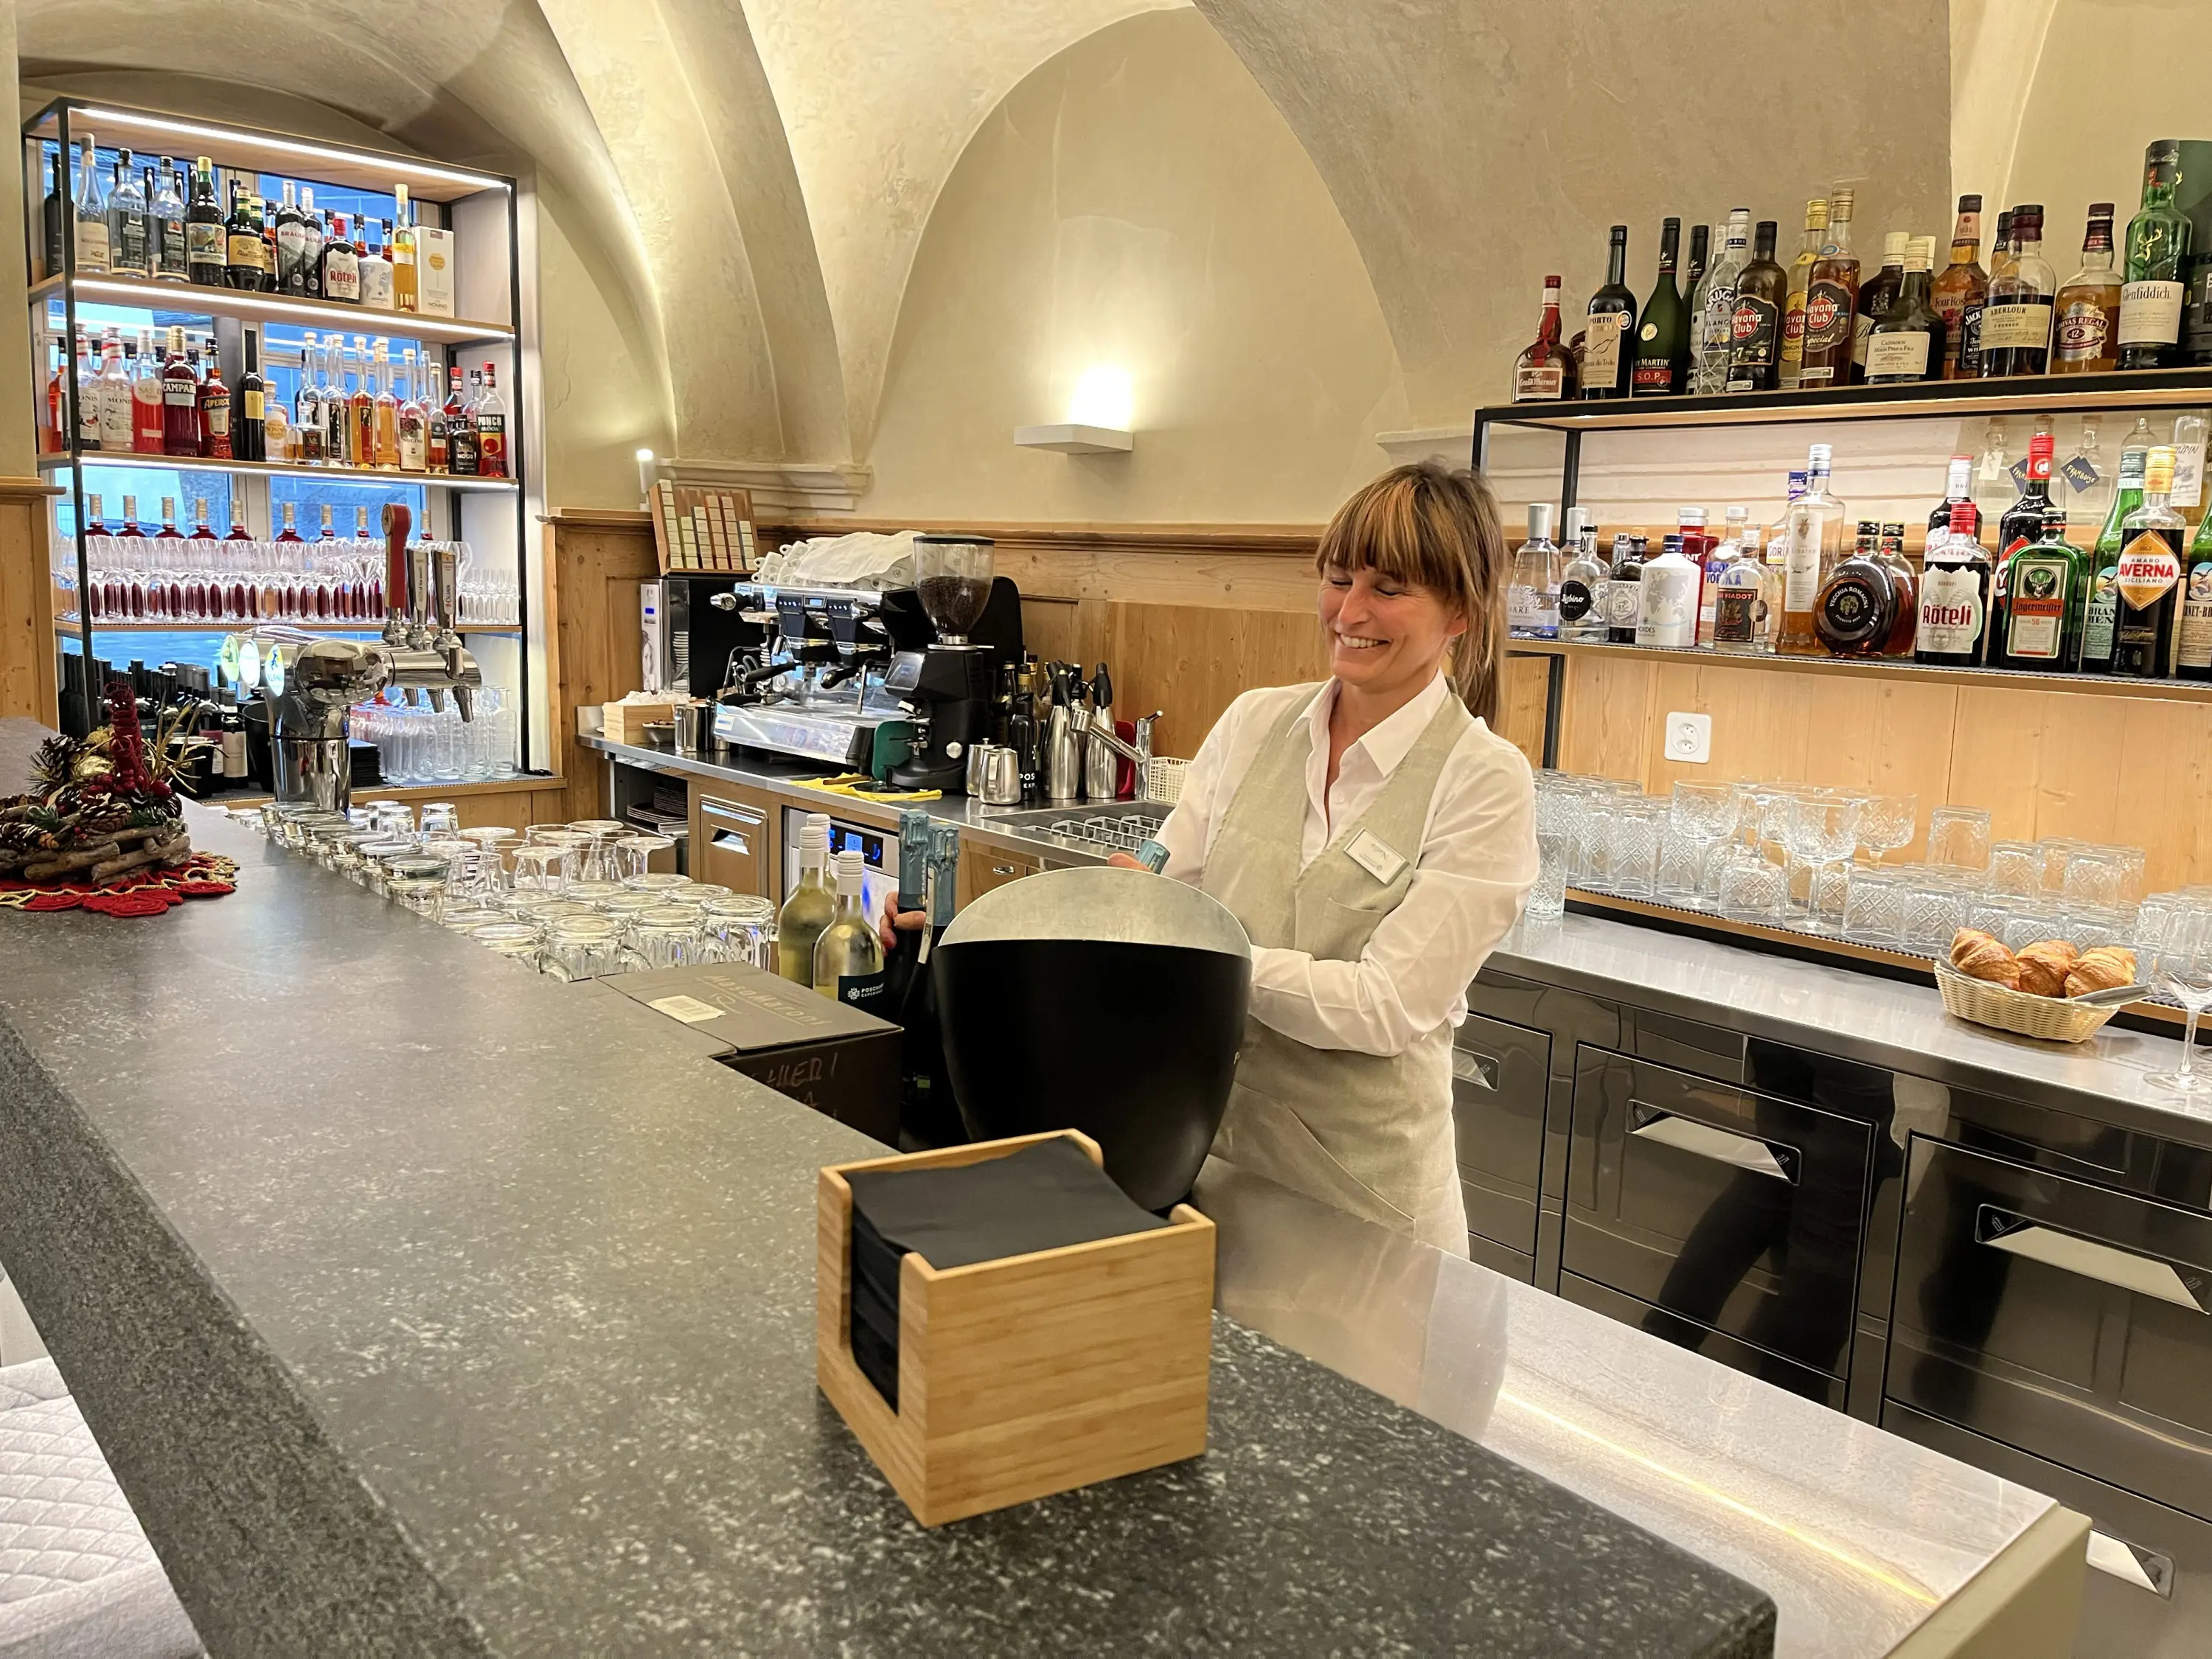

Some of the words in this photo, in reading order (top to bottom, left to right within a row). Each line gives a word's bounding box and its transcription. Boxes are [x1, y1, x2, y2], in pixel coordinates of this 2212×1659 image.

[280, 231, 307, 240] BRAULI
[2122, 285, 2171, 302] Glenfiddich
[1935, 297, 1951, 307] Four
[1950, 296, 1966, 306] Ros
[1990, 306, 2027, 316] ABERLOUR
[1589, 316, 1612, 325] PORTO
[1809, 313, 1829, 324] Club
[1965, 311, 1981, 325] JACK
[1733, 322, 1753, 333] Club
[2056, 317, 2077, 331] CHIVAS
[2078, 317, 2105, 329] REGAL
[2071, 329, 2080, 338] 12
[1736, 347, 1745, 359] 7
[1641, 358, 1669, 366] MARTIN
[163, 383, 197, 394] CAMPARI
[2012, 467, 2026, 479] FRAM
[2118, 563, 2174, 579] AVERNA
[1922, 604, 1972, 626] Röteli
